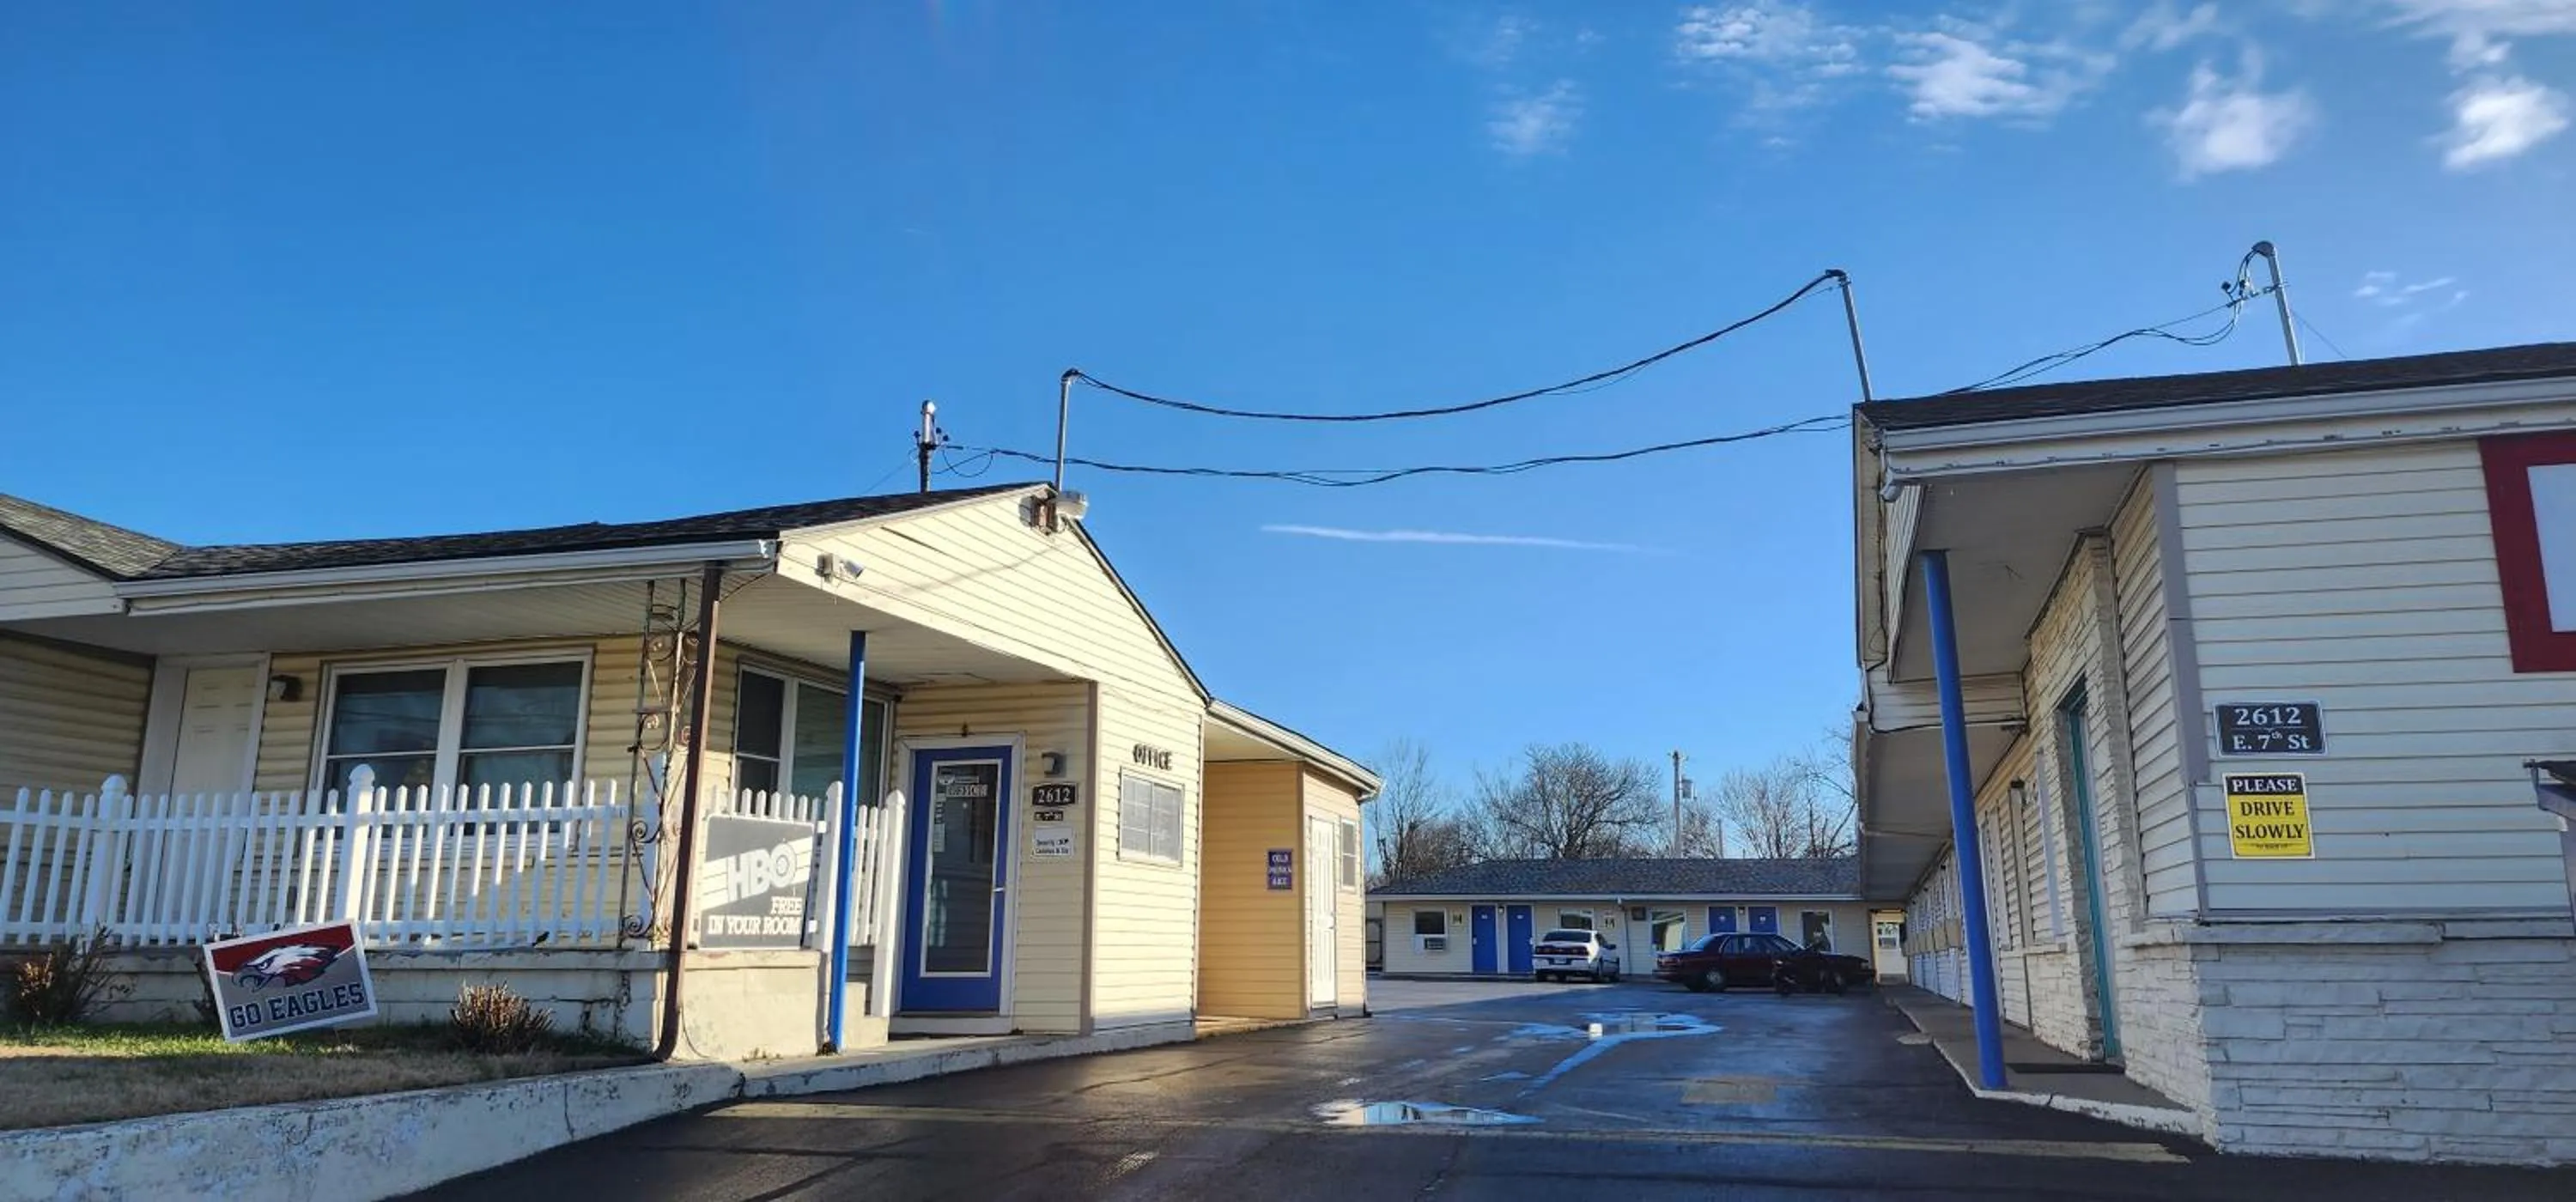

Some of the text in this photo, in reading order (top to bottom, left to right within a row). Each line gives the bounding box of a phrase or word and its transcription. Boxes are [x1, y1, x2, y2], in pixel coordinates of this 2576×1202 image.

[2234, 707, 2302, 725] 2612
[2233, 731, 2311, 750] E. 7th St
[1133, 743, 1172, 771] OFFICE
[2233, 779, 2297, 792] PLEASE
[1037, 787, 1071, 803] 2612
[2240, 801, 2295, 816] DRIVE
[2235, 824, 2305, 839] SLOWLY
[728, 842, 798, 902] HBO
[771, 896, 802, 914] FREE
[708, 915, 801, 935] IN YOUR ROOM
[229, 983, 366, 1029] GO EAGLES
